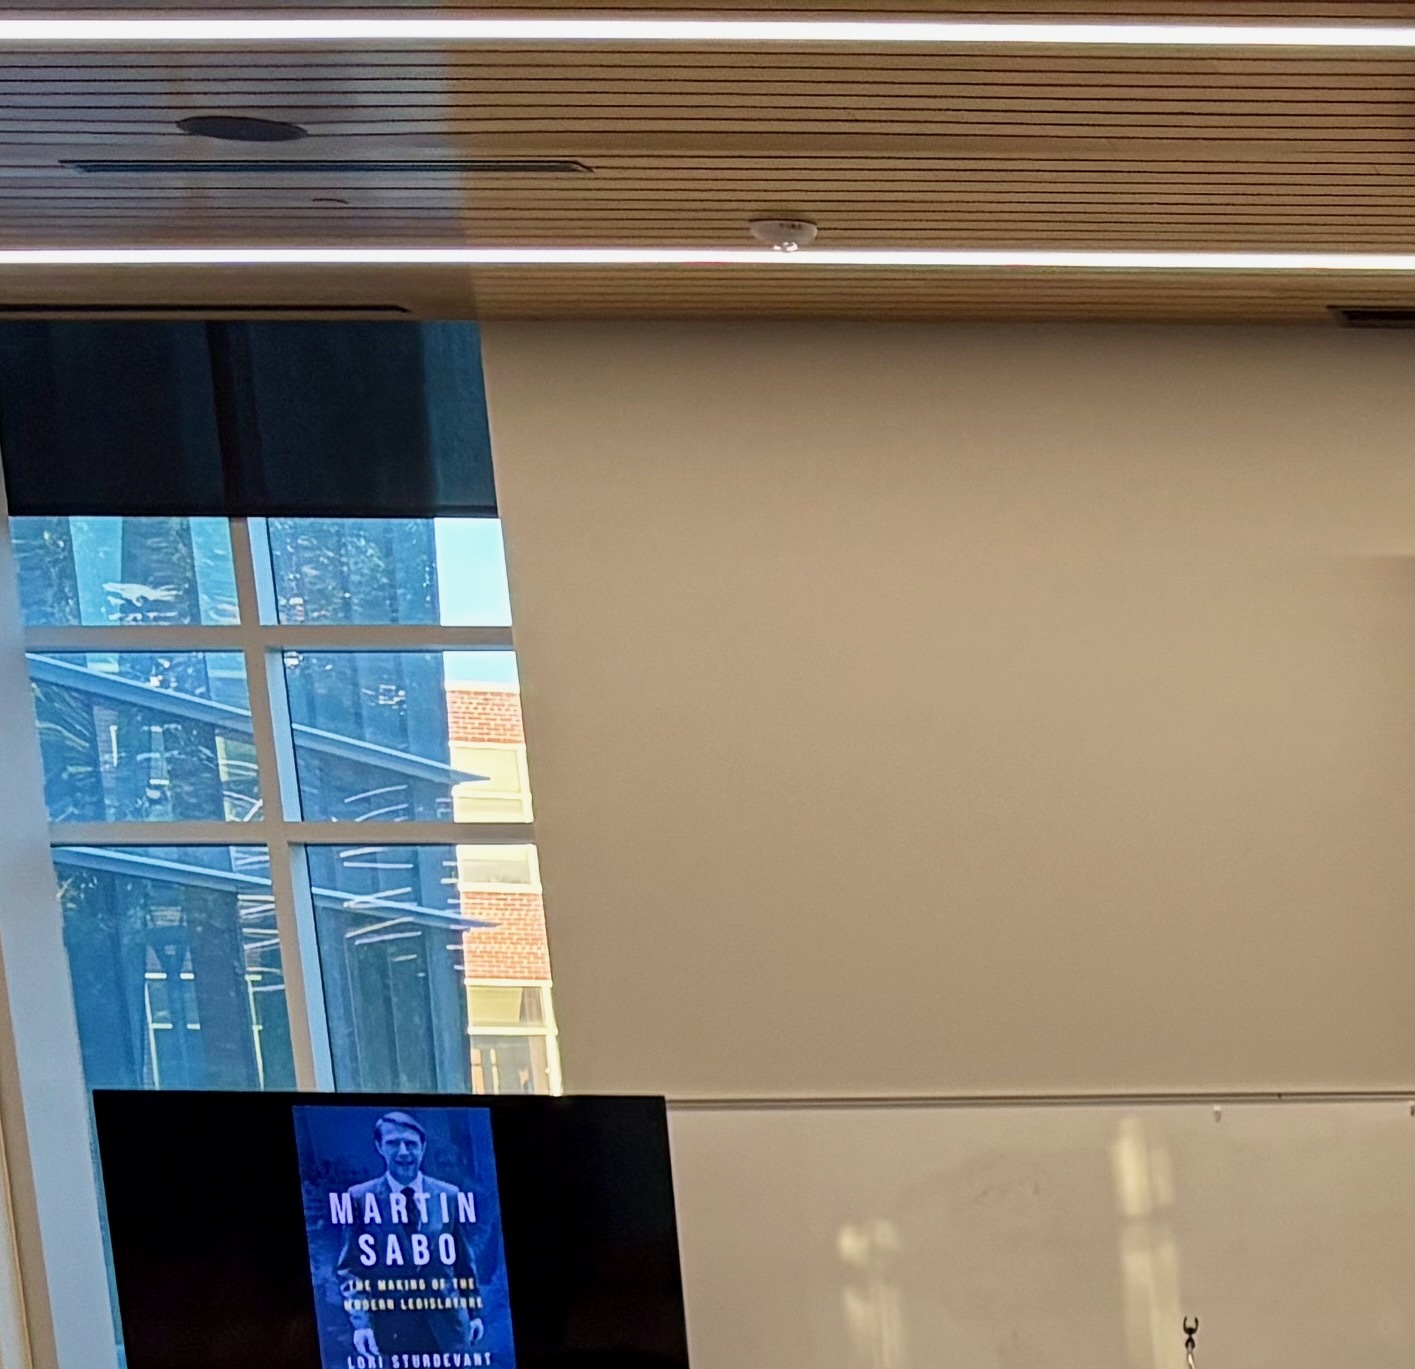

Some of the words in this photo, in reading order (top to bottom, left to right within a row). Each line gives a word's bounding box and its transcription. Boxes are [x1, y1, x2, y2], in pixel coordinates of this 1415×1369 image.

[329, 1192, 476, 1224] MARTIN
[358, 1233, 457, 1266] SABO
[349, 1278, 371, 1292] THE
[378, 1277, 426, 1291] MAKING
[431, 1277, 446, 1291] OF
[452, 1277, 475, 1290] THE
[400, 1296, 484, 1311] LEGISLATURE
[347, 1355, 383, 1369] LORI
[391, 1352, 491, 1369] STURDEVANT
